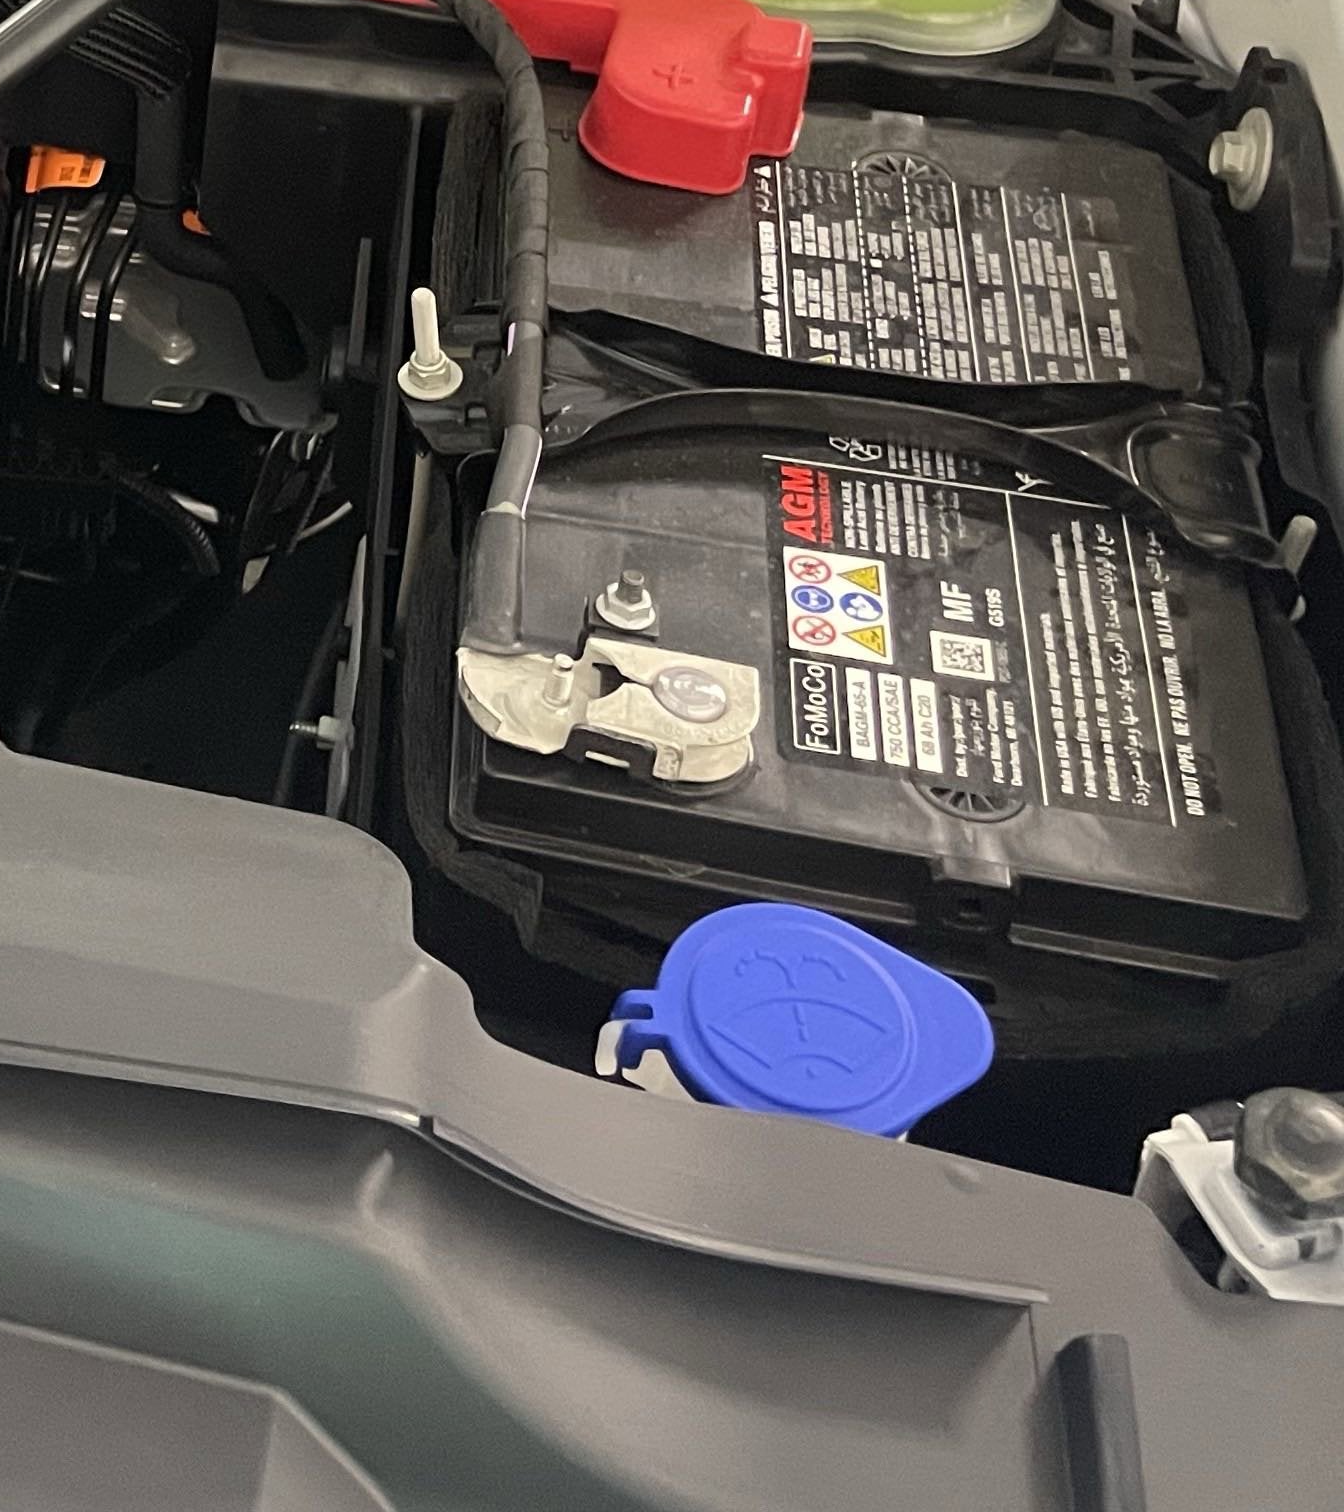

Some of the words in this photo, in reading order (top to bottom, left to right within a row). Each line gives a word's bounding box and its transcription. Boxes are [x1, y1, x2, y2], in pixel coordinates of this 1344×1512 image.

[780, 465, 816, 542] AGM
[940, 582, 974, 621] MF
[986, 589, 1005, 626] G519S
[1151, 586, 1172, 619] ABRA.
[1157, 618, 1175, 634] LA
[803, 665, 829, 749] FoMoCo
[853, 681, 870, 747] BAGM-65-A
[884, 680, 901, 736] CCA/SAE
[916, 696, 932, 717] C20
[1170, 698, 1189, 721] PAS
[918, 722, 934, 737] Ah
[886, 740, 903, 759] 750
[1177, 741, 1198, 775] OPEN.
[1183, 774, 1202, 799] NOT
[1187, 798, 1205, 816] DO
